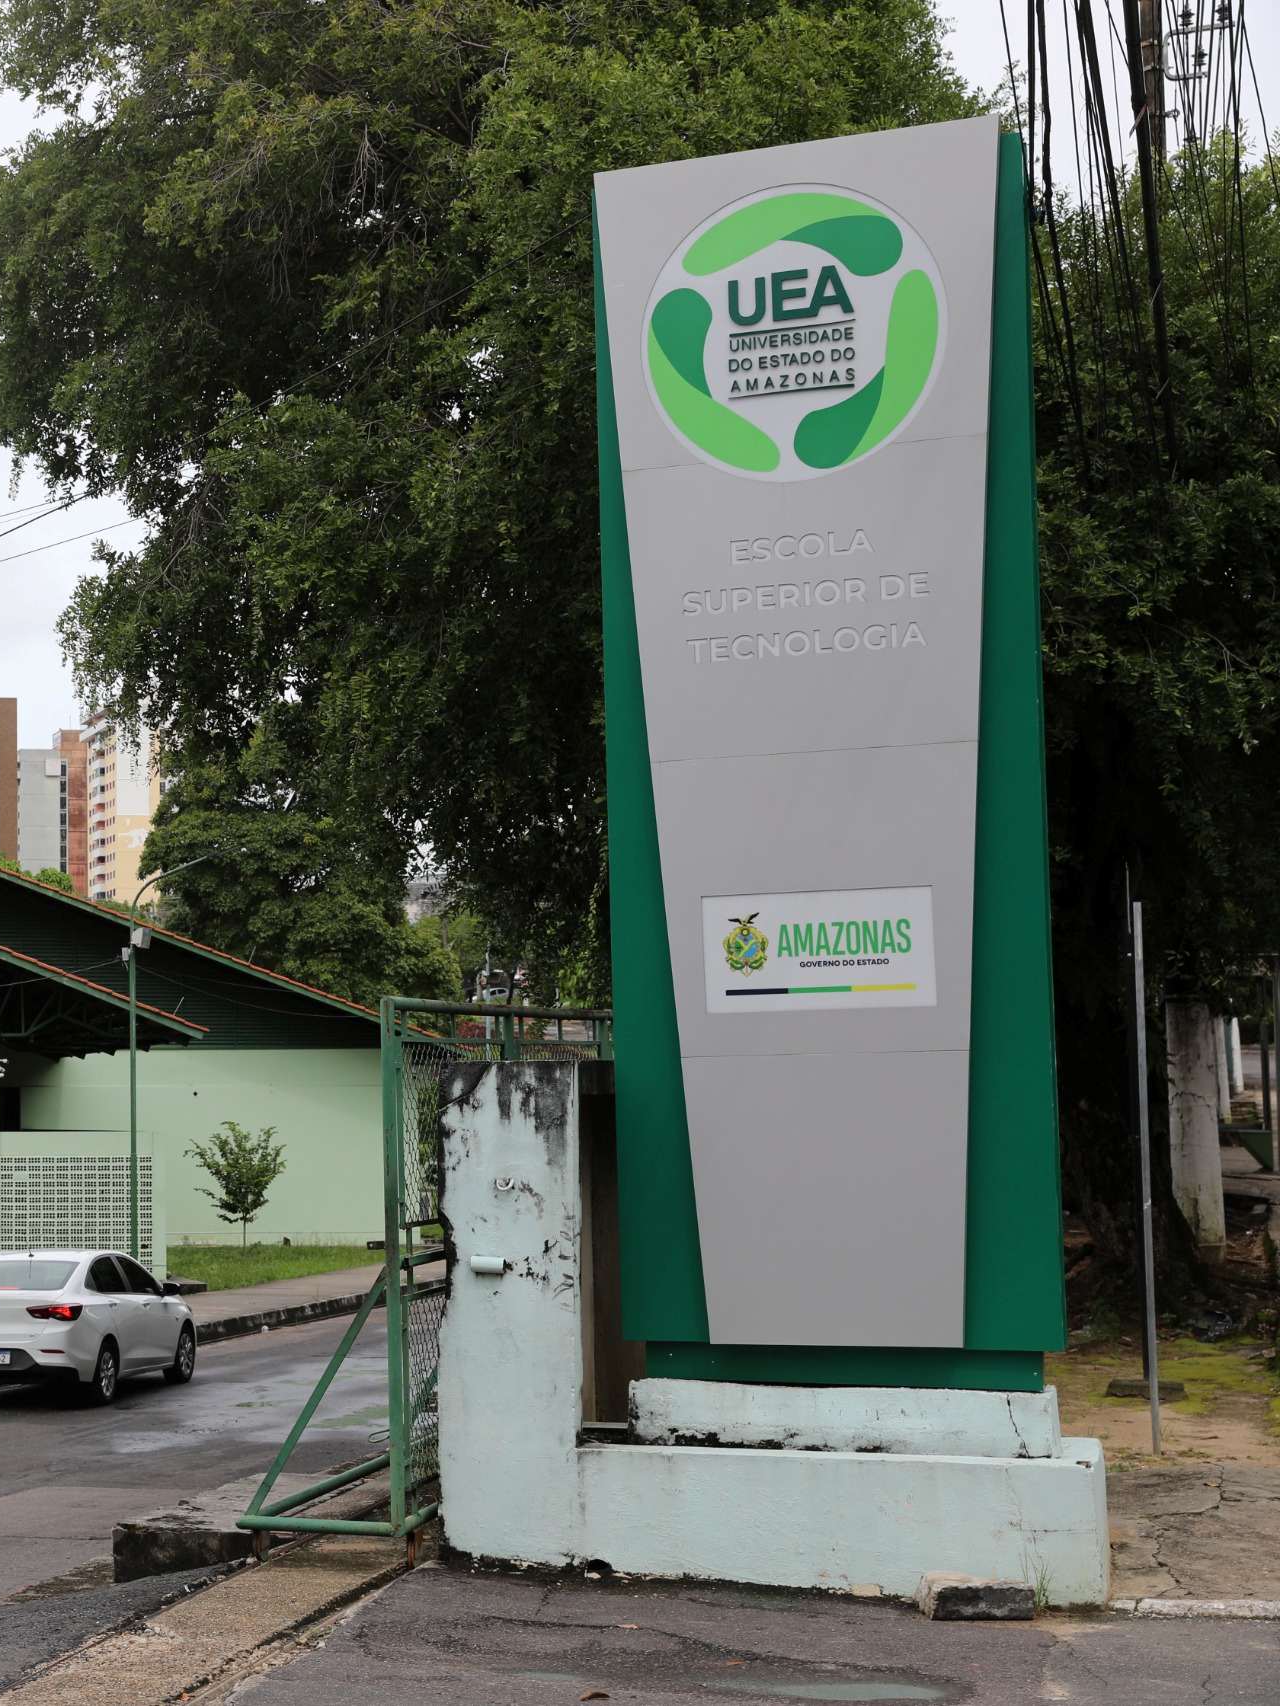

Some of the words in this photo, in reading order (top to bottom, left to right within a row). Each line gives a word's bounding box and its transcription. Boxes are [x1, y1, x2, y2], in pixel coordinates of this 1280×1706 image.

[728, 265, 854, 326] UEA
[729, 326, 854, 353] UNIVERSIDADE
[728, 357, 753, 373] DO
[758, 350, 825, 370] ESTADO
[830, 347, 856, 363] DO
[730, 368, 856, 393] AMAZONAS
[729, 528, 875, 565] ESCOLA
[681, 577, 867, 616] SUPERIOR
[879, 571, 931, 600] DE
[685, 621, 928, 664] TECNOLOGIA
[777, 918, 912, 958] AMAZONAS
[799, 959, 840, 968] GOVERNO
[842, 959, 855, 967] DO
[857, 958, 890, 966] ESTADO
